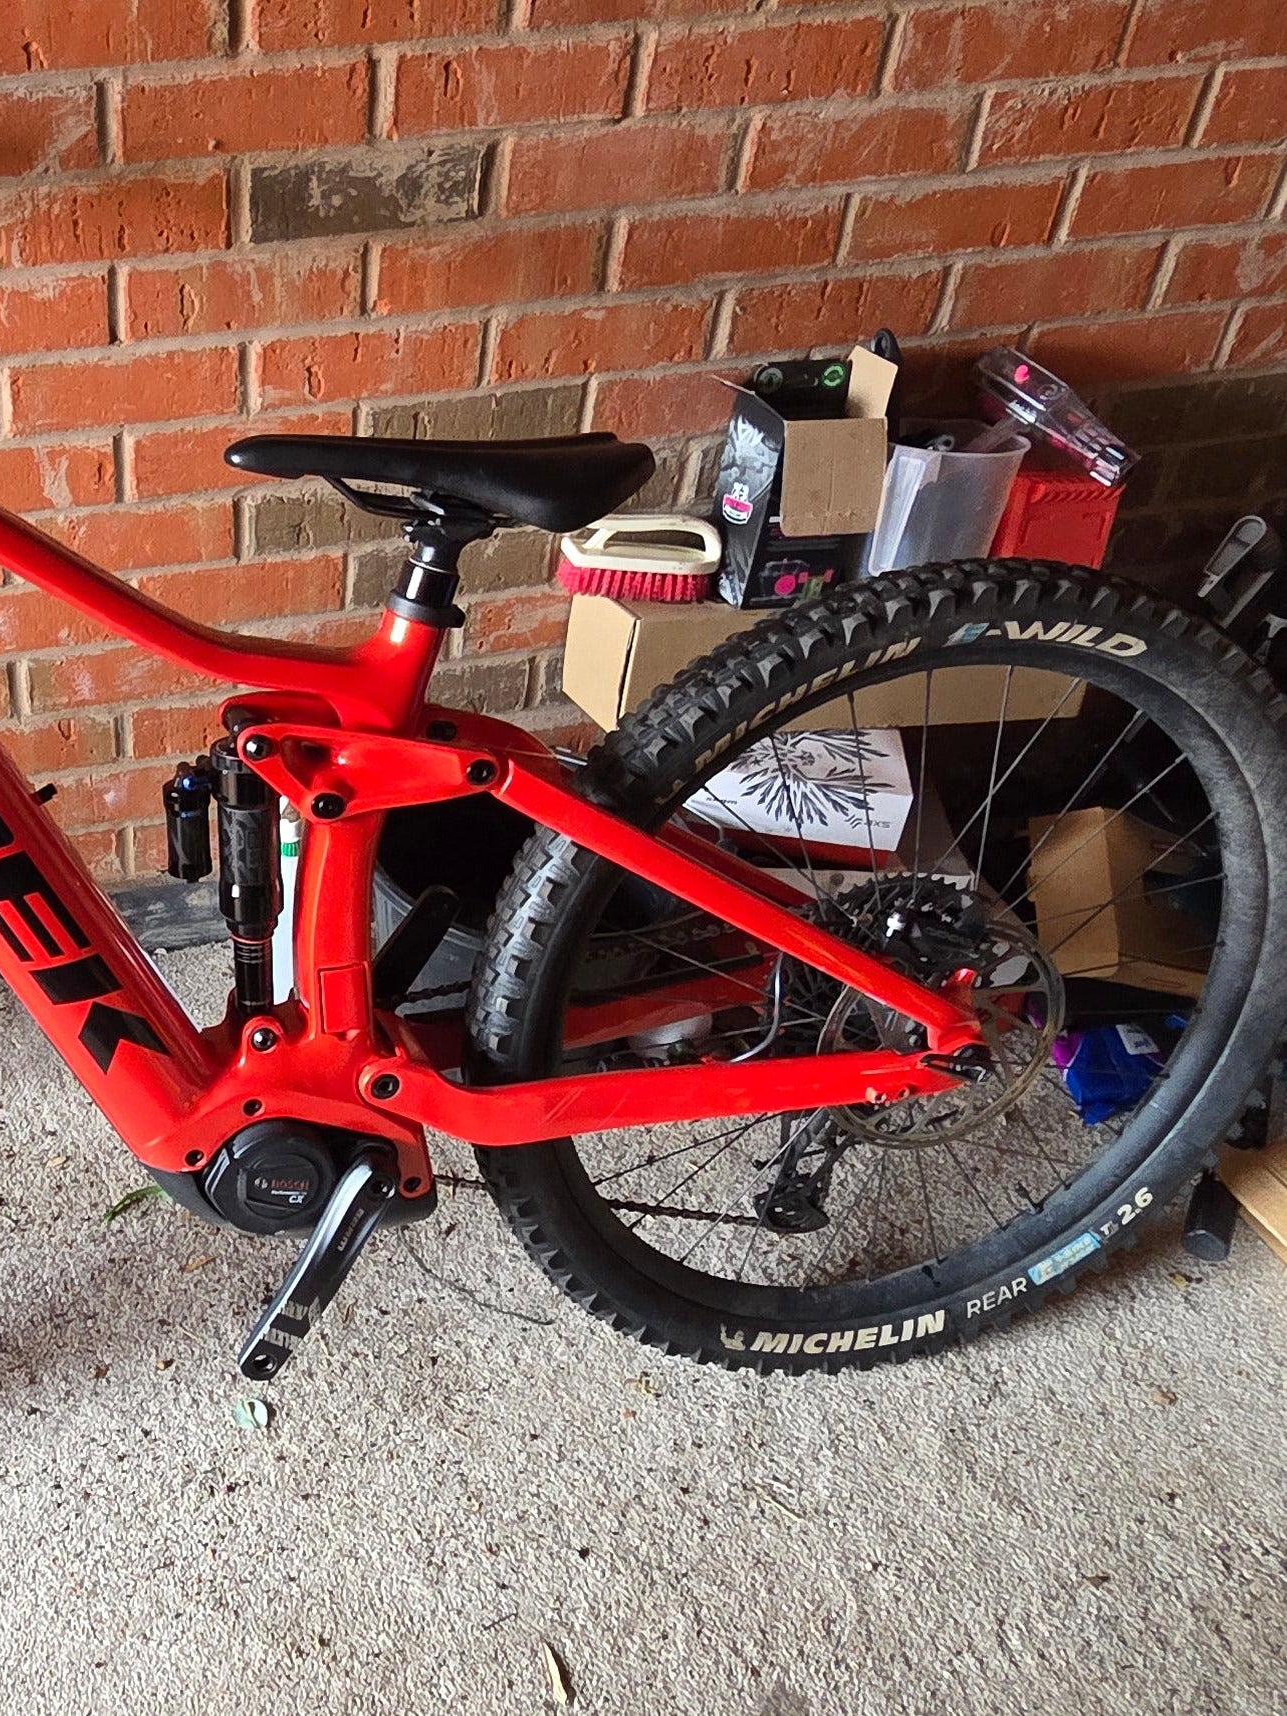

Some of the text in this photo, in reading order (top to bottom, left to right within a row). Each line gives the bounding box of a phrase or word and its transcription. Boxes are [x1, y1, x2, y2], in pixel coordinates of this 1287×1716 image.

[694, 637, 922, 774] MICHELIN
[750, 1186, 1154, 1354] MICHELIN REAR 2.6
